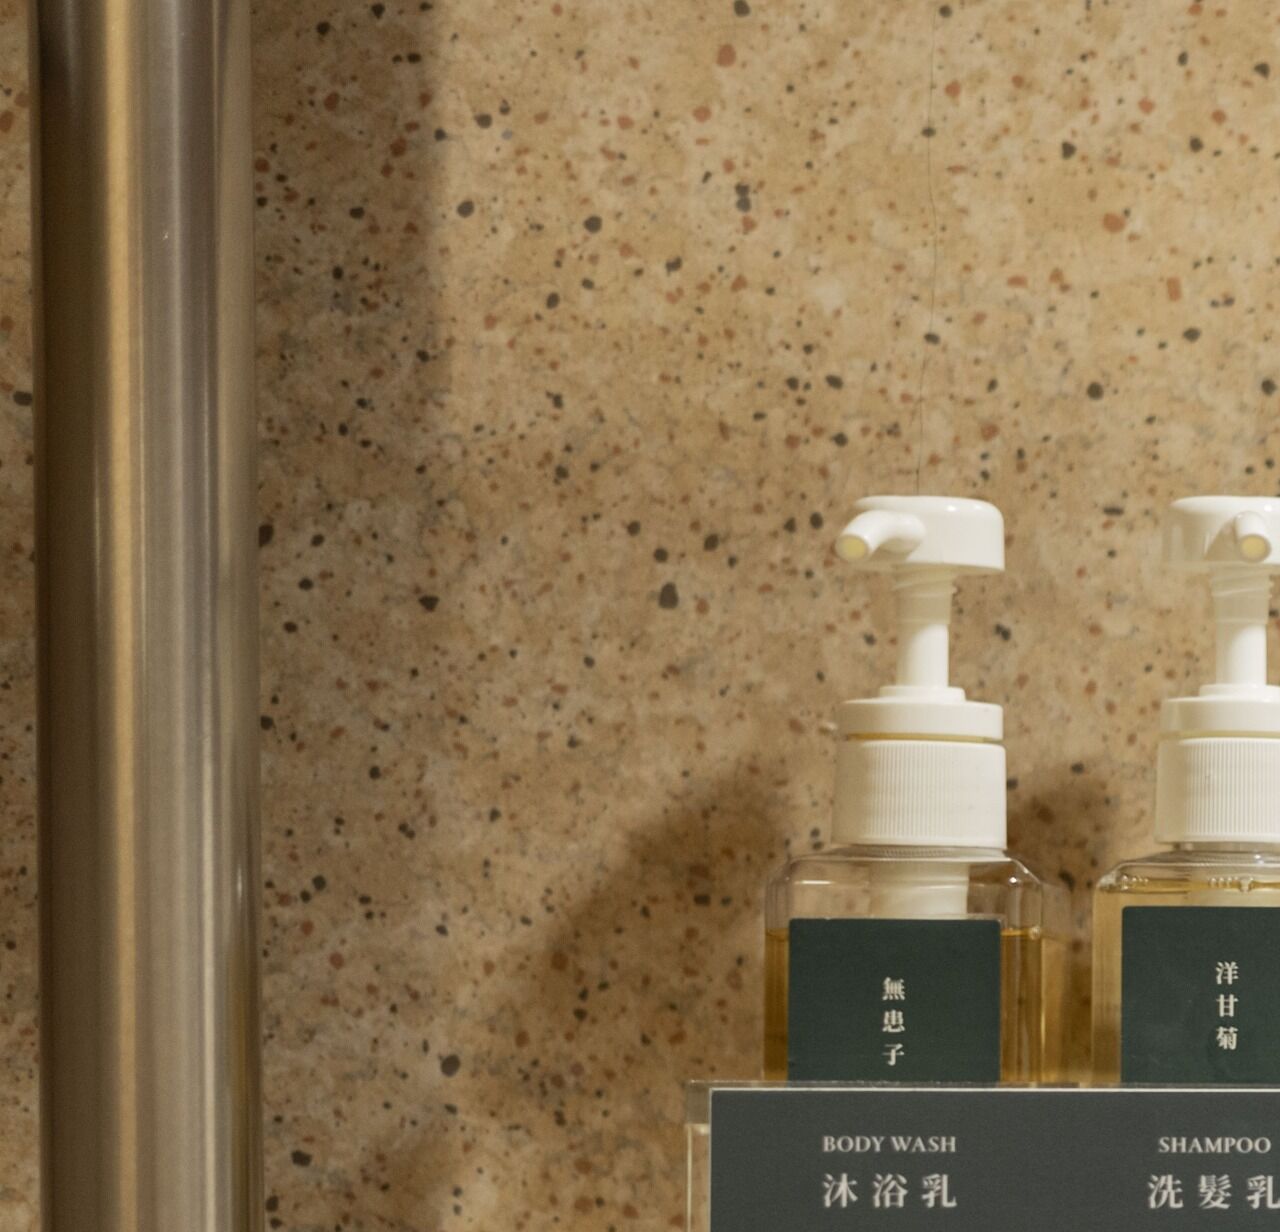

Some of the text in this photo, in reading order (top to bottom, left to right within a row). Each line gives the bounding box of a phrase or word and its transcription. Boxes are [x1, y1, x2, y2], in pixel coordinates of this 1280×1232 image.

[881, 976, 906, 1067] 無患子
[1215, 961, 1239, 1051] 洋甘菊
[823, 1135, 956, 1153] BODY WASH
[1158, 1136, 1272, 1154] SHAMPOO
[823, 1172, 958, 1209] 沐浴乳
